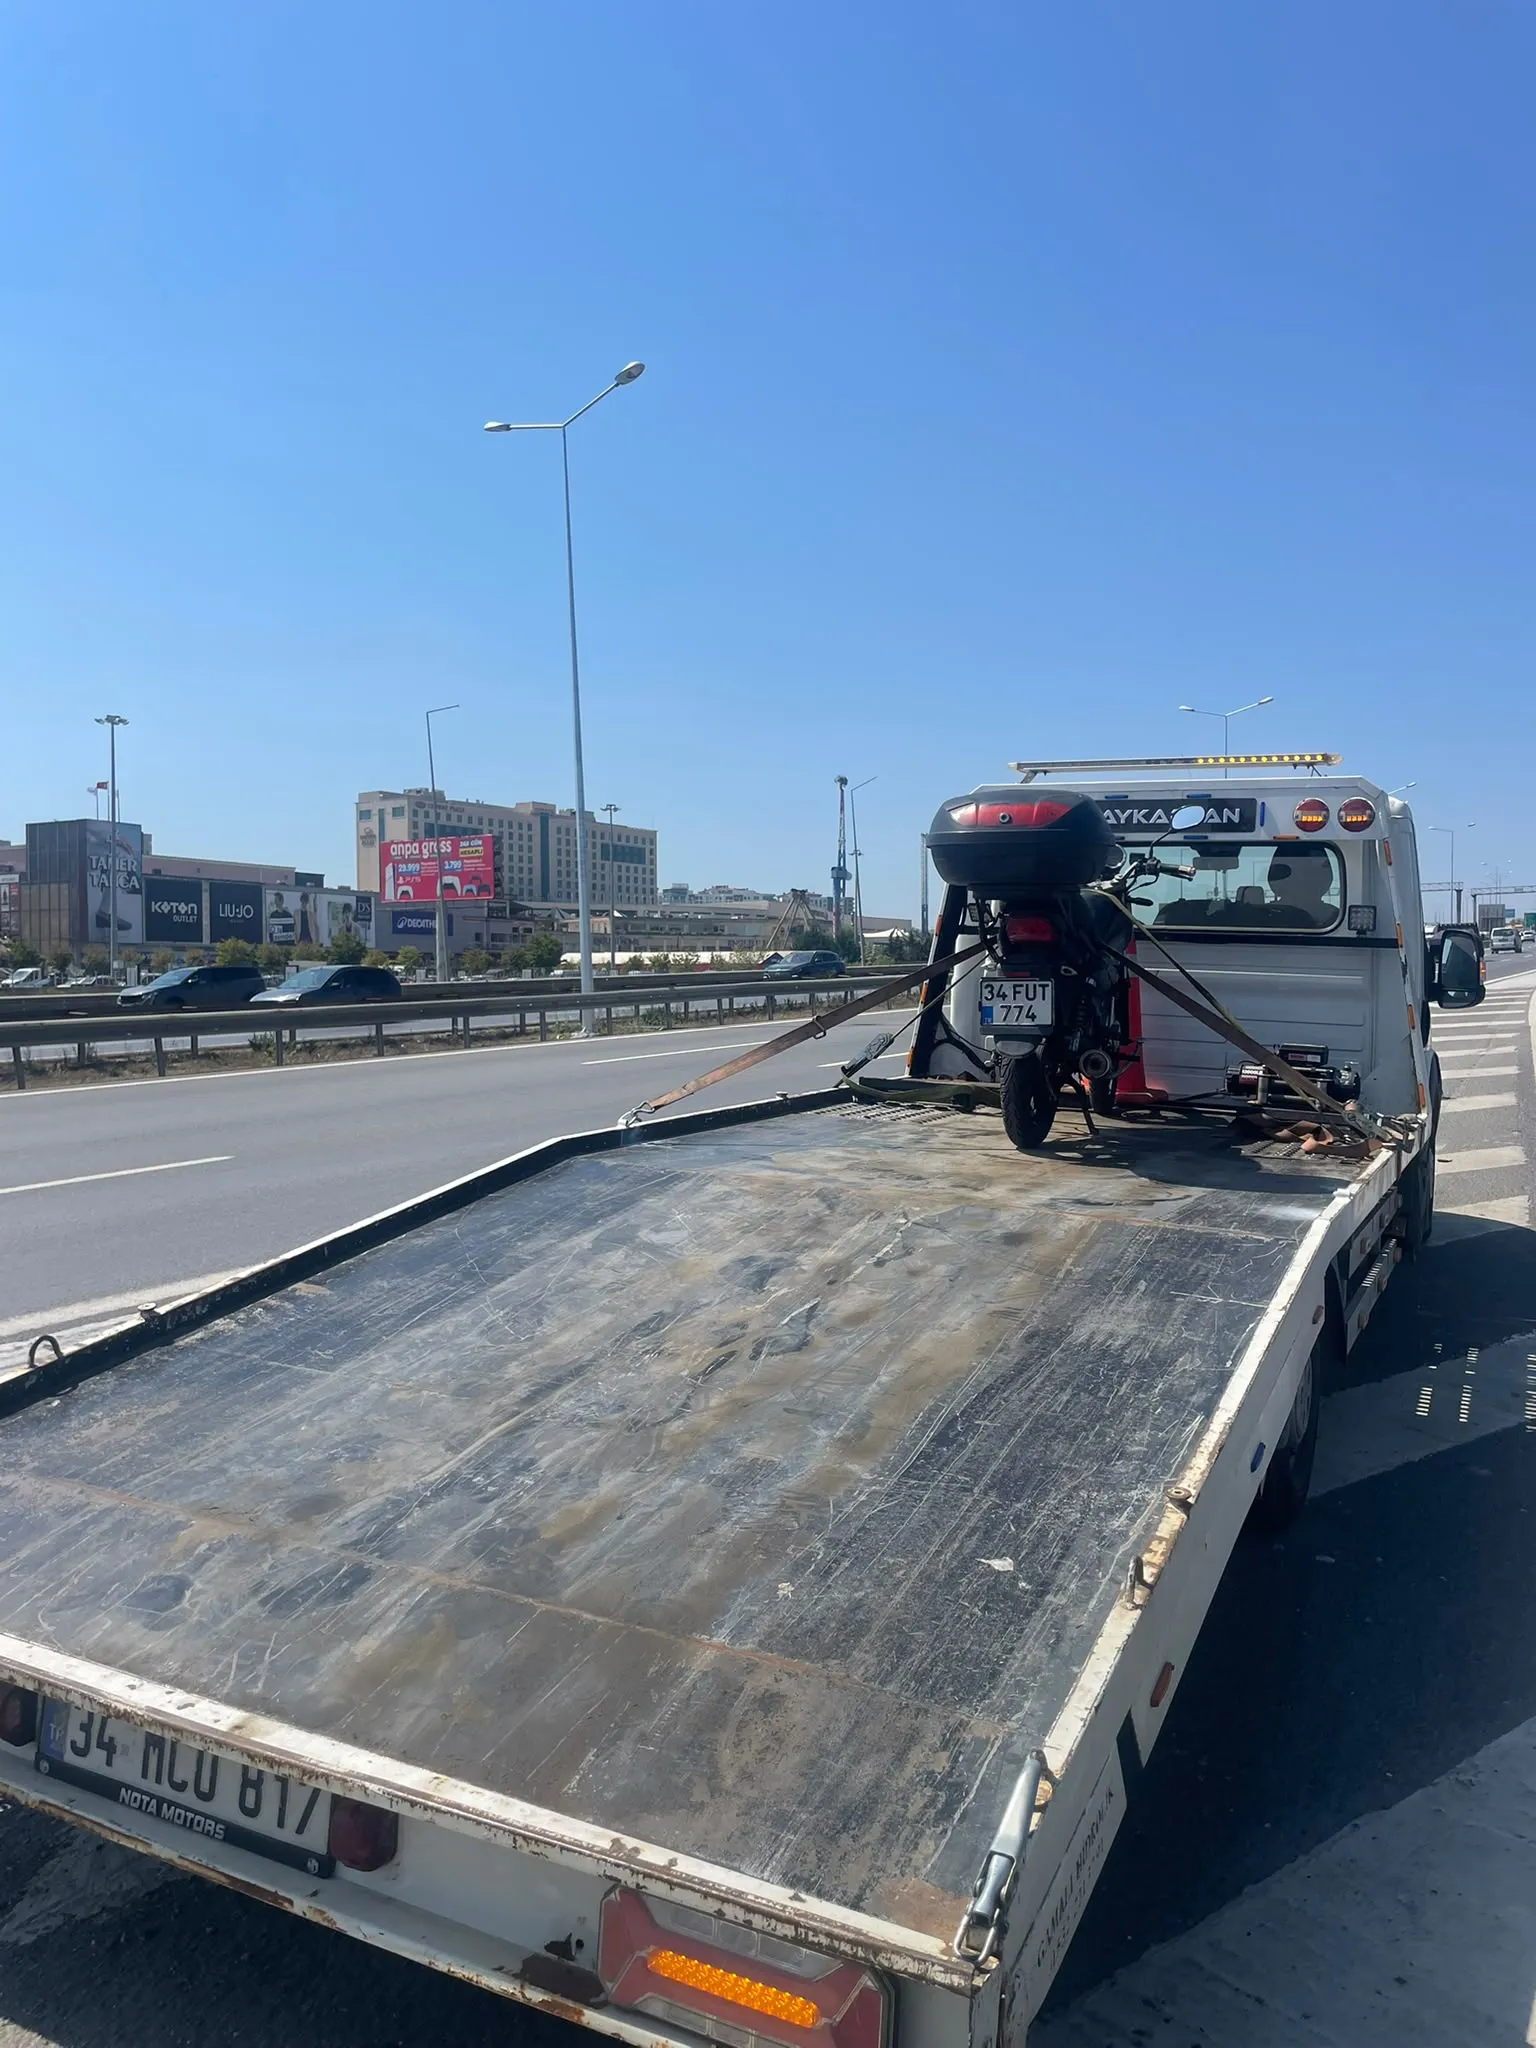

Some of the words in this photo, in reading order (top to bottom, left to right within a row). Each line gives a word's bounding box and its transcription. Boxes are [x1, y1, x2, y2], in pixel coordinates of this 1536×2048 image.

[1103, 807, 1241, 824] AYKAAN
[390, 841, 419, 859] anpa
[172, 915, 198, 924] OUTLET
[407, 918, 435, 929] DECATH
[984, 983, 1008, 1001] 34
[1012, 983, 1050, 1001] FUT
[999, 1004, 1037, 1022] 774
[70, 1707, 118, 1767] 34
[119, 1787, 158, 1817] NOTA
[160, 1802, 226, 1840] MOTORS
